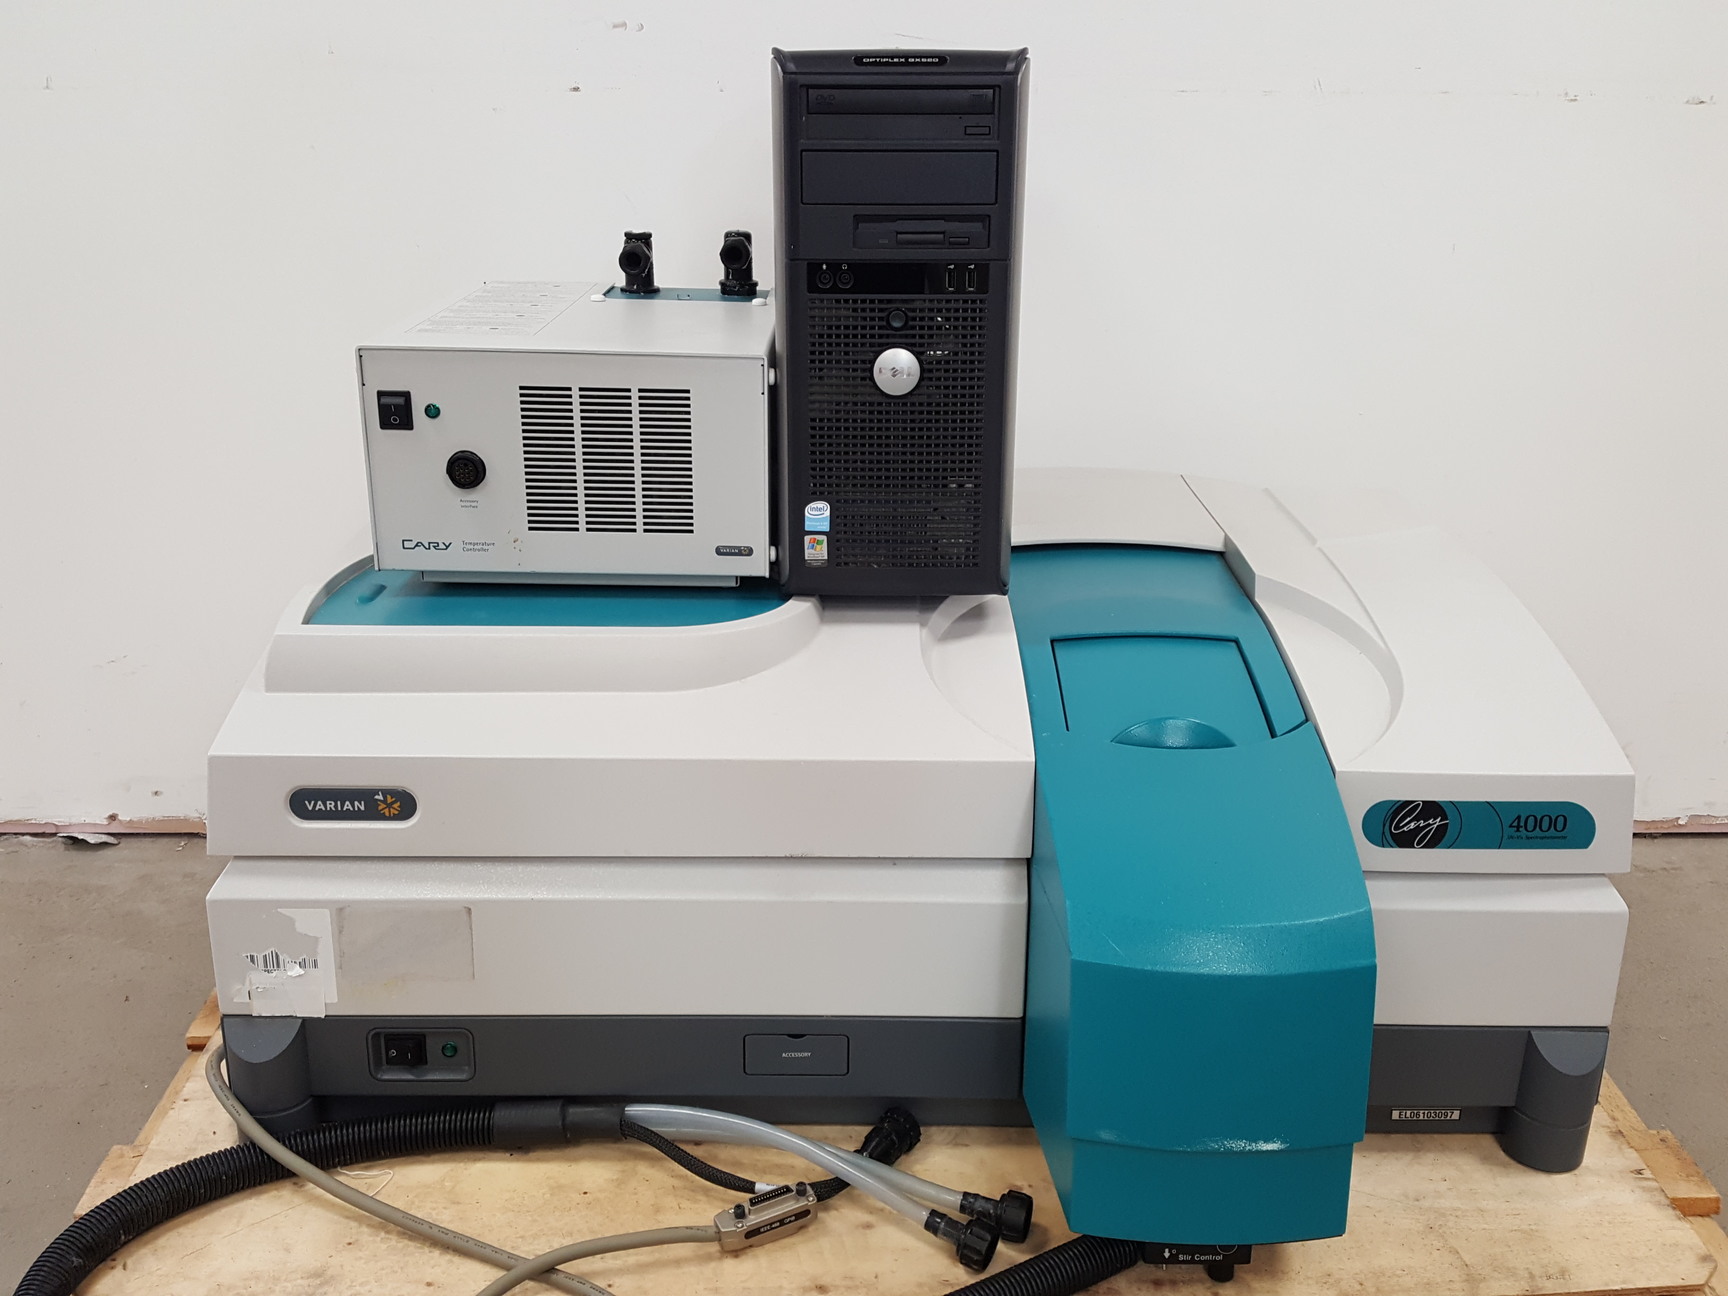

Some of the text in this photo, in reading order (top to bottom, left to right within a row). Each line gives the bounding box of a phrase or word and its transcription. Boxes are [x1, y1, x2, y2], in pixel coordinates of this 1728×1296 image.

[402, 539, 452, 551] CARY
[305, 800, 365, 811] VARIAN
[1391, 801, 1449, 848] Cary
[1508, 814, 1568, 833] 4000
[1398, 1111, 1455, 1119] EL06103097
[1194, 1253, 1223, 1261] Control
